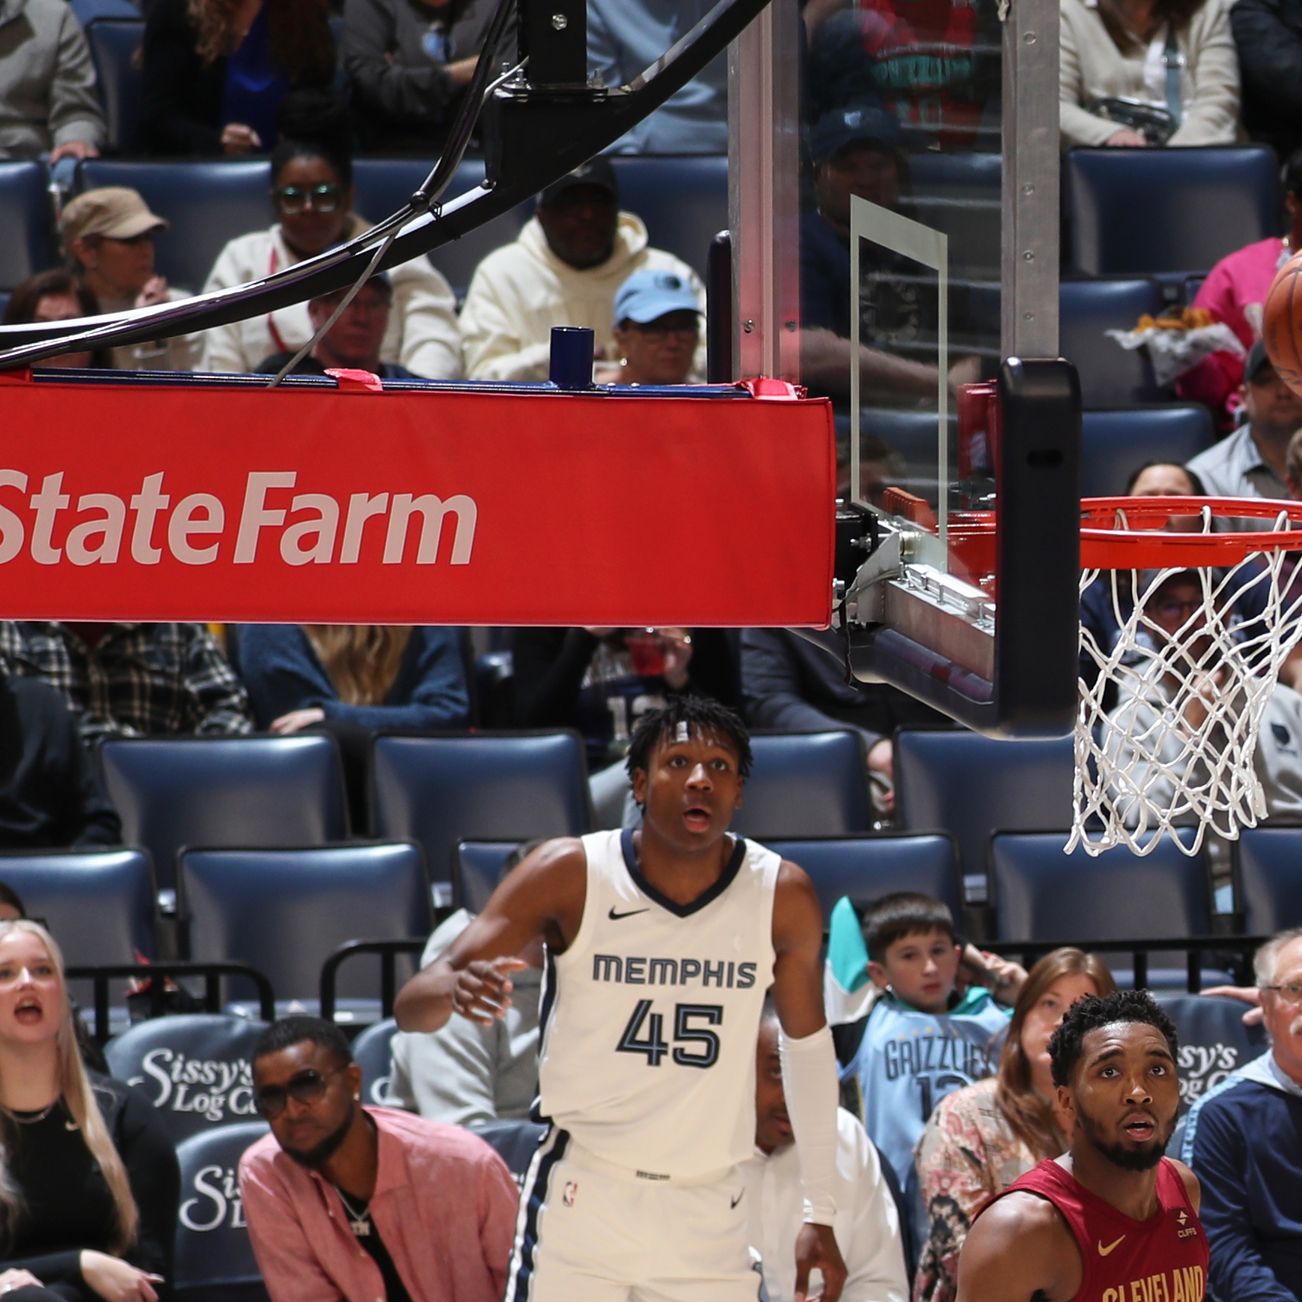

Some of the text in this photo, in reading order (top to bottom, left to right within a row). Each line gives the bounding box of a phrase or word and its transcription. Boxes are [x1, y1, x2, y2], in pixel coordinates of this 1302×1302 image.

[0, 469, 478, 567] State Farm
[592, 953, 758, 989] MEMPHIS
[615, 999, 724, 1069] 45
[172, 1083, 225, 1122] Log
[1177, 1226, 1198, 1239] CLIFFS
